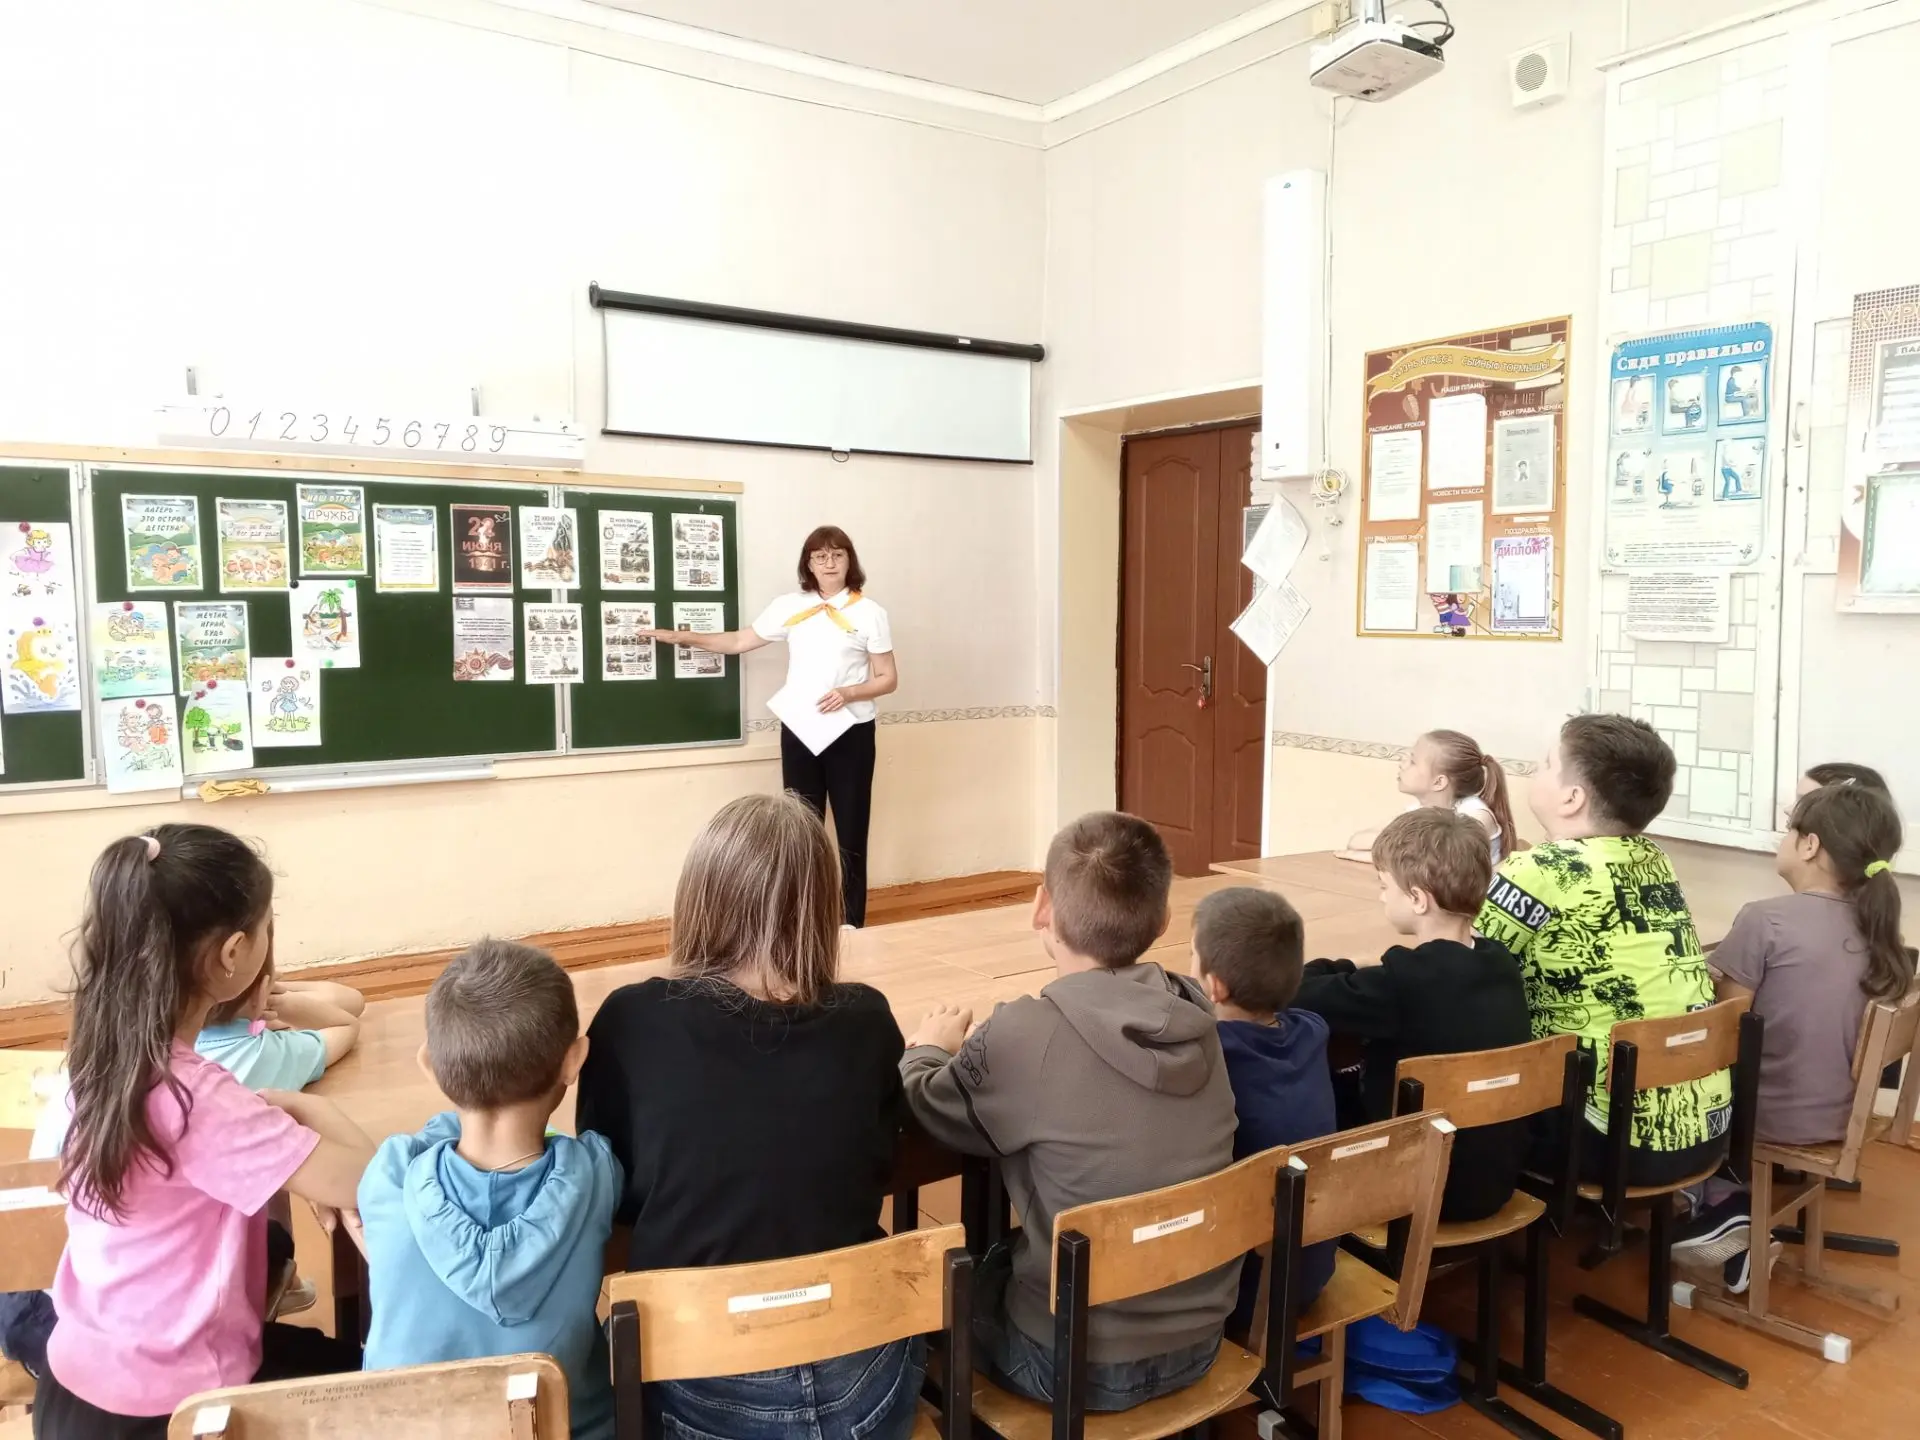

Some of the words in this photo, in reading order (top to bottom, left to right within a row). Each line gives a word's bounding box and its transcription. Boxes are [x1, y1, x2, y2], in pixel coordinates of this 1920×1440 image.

[1880, 303, 1920, 328] УР
[1616, 354, 1661, 371] Сиди
[1664, 339, 1766, 367] правильно
[210, 407, 231, 437] 0
[249, 411, 262, 440] 1
[279, 412, 297, 441] 2
[310, 414, 329, 442] 3
[343, 416, 359, 444] 4
[373, 418, 391, 446] 5
[403, 421, 422, 448] 6
[434, 423, 450, 449] 7
[461, 425, 479, 452] 8
[489, 426, 506, 453] 9
[1432, 488, 1460, 498] НОВОСТИ
[1460, 487, 1485, 496] КЛАССА
[307, 510, 355, 521] ДРУЖБА
[468, 516, 495, 538] 22
[462, 541, 502, 552] ИЮНЯ
[1496, 544, 1541, 558] ДИПЛОМ
